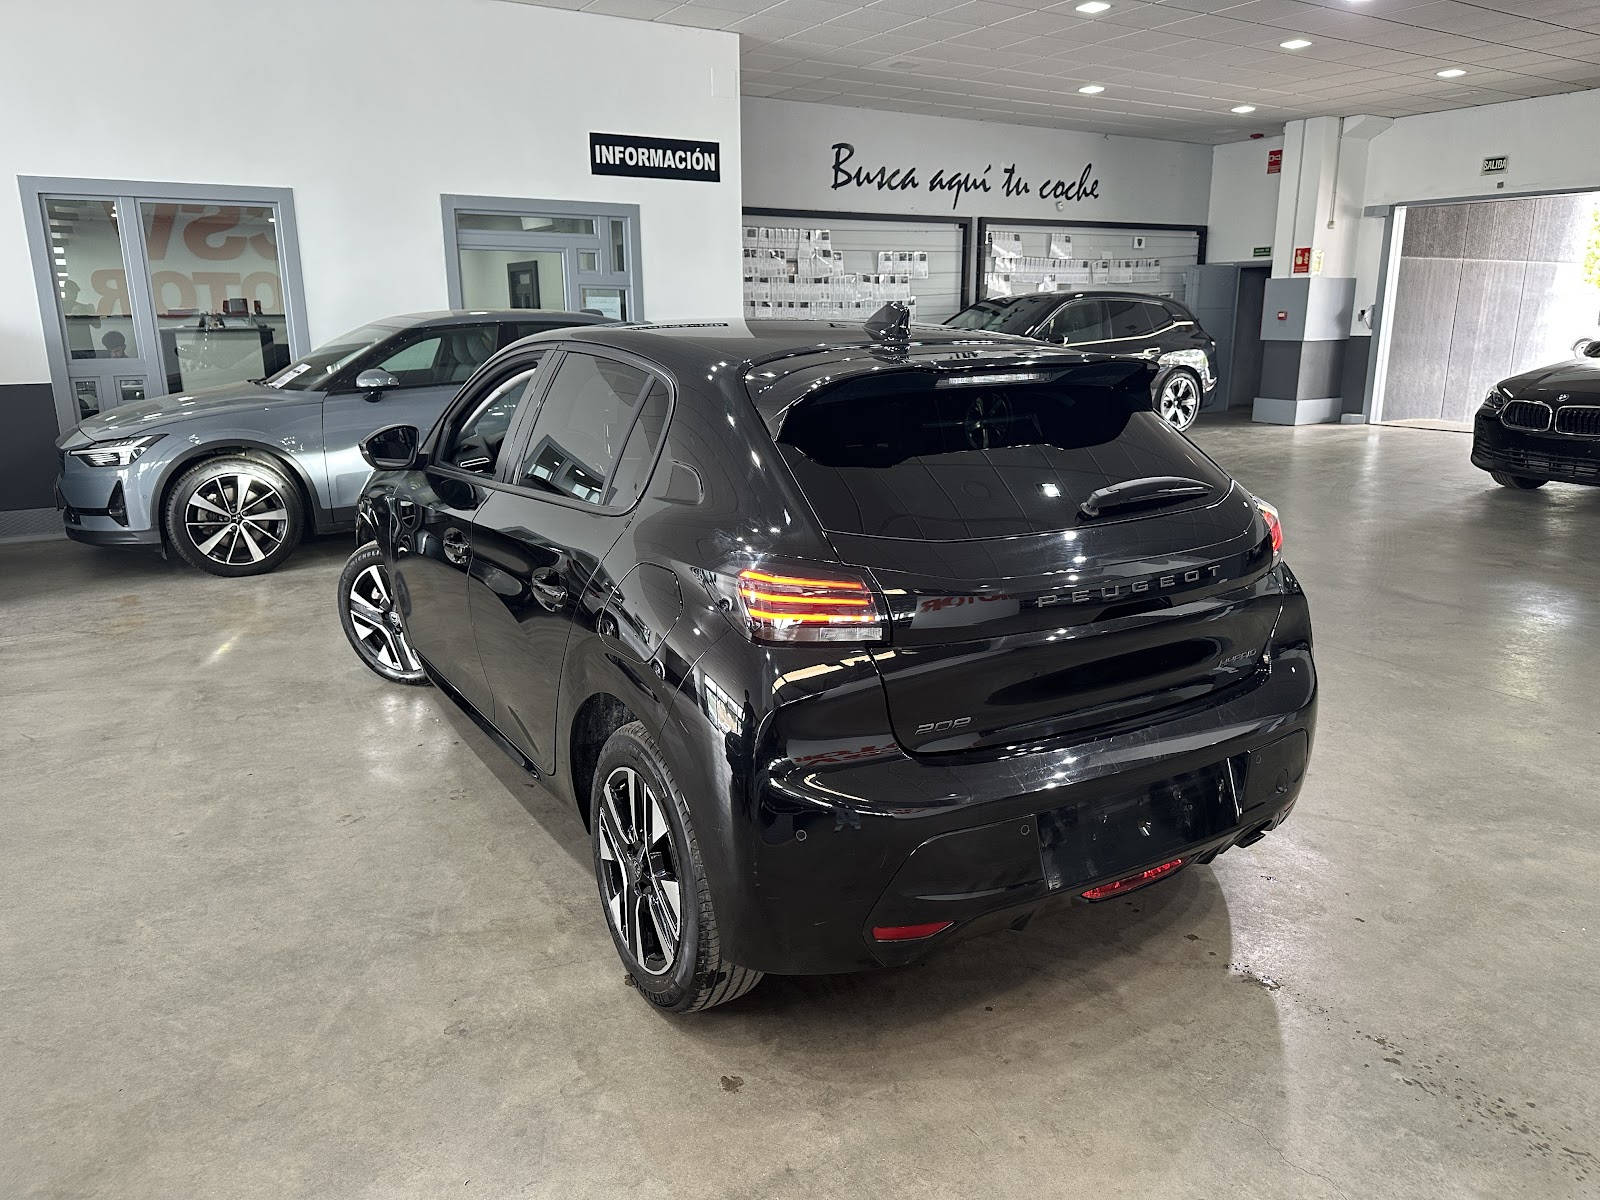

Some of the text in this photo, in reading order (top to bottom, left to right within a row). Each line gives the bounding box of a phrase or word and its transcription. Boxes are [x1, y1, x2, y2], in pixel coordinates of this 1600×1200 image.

[594, 144, 716, 172] INFORMACIÓN
[1484, 159, 1507, 170] SALIDA
[831, 142, 1099, 210] Busca aquí tu coche
[1038, 564, 1221, 608] PEUGEOT
[914, 716, 972, 735] 208
